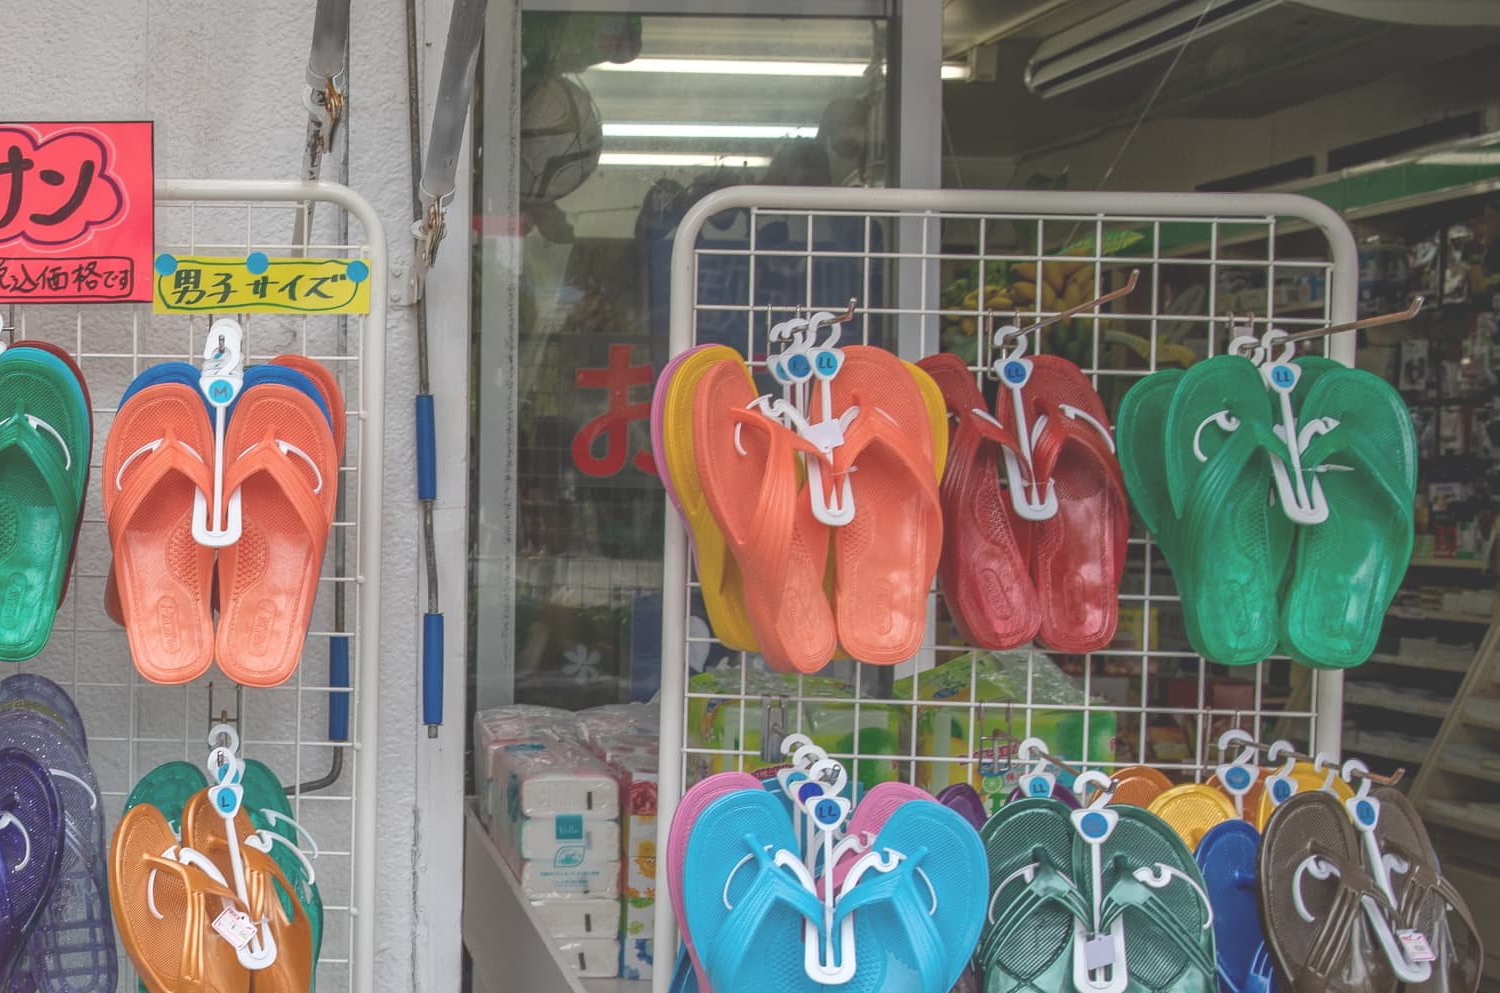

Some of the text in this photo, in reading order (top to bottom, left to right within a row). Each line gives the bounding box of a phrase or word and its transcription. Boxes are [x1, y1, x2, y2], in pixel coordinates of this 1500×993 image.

[818, 356, 834, 369] LL
[1275, 370, 1291, 383] LL
[213, 385, 228, 399] M
[1032, 784, 1047, 794] LL
[221, 795, 230, 808] L
[818, 805, 838, 818] LL
